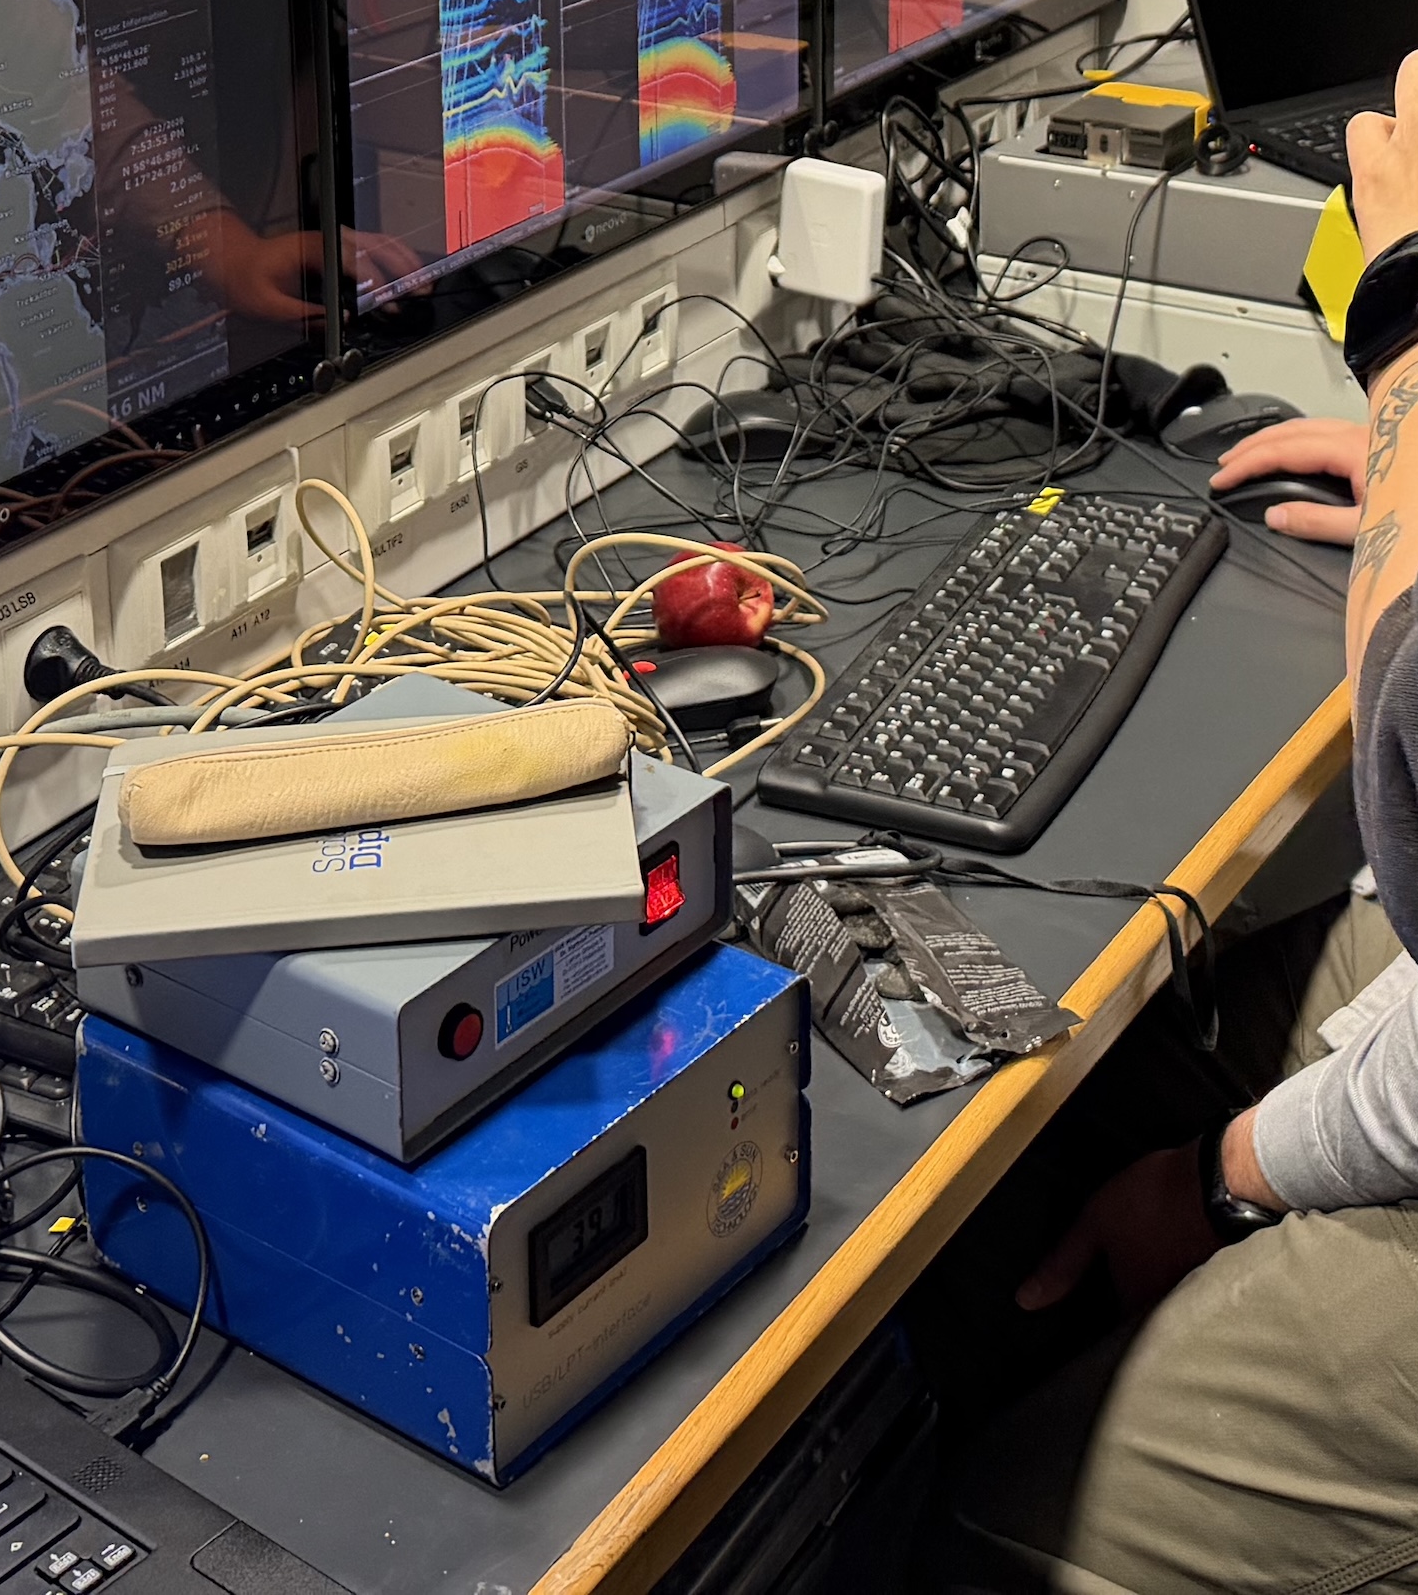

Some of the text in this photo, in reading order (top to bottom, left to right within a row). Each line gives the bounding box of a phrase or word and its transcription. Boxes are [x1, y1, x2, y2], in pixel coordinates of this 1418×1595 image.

[137, 381, 167, 411] NM
[12, 591, 37, 614] LSB
[515, 957, 547, 994] ISW
